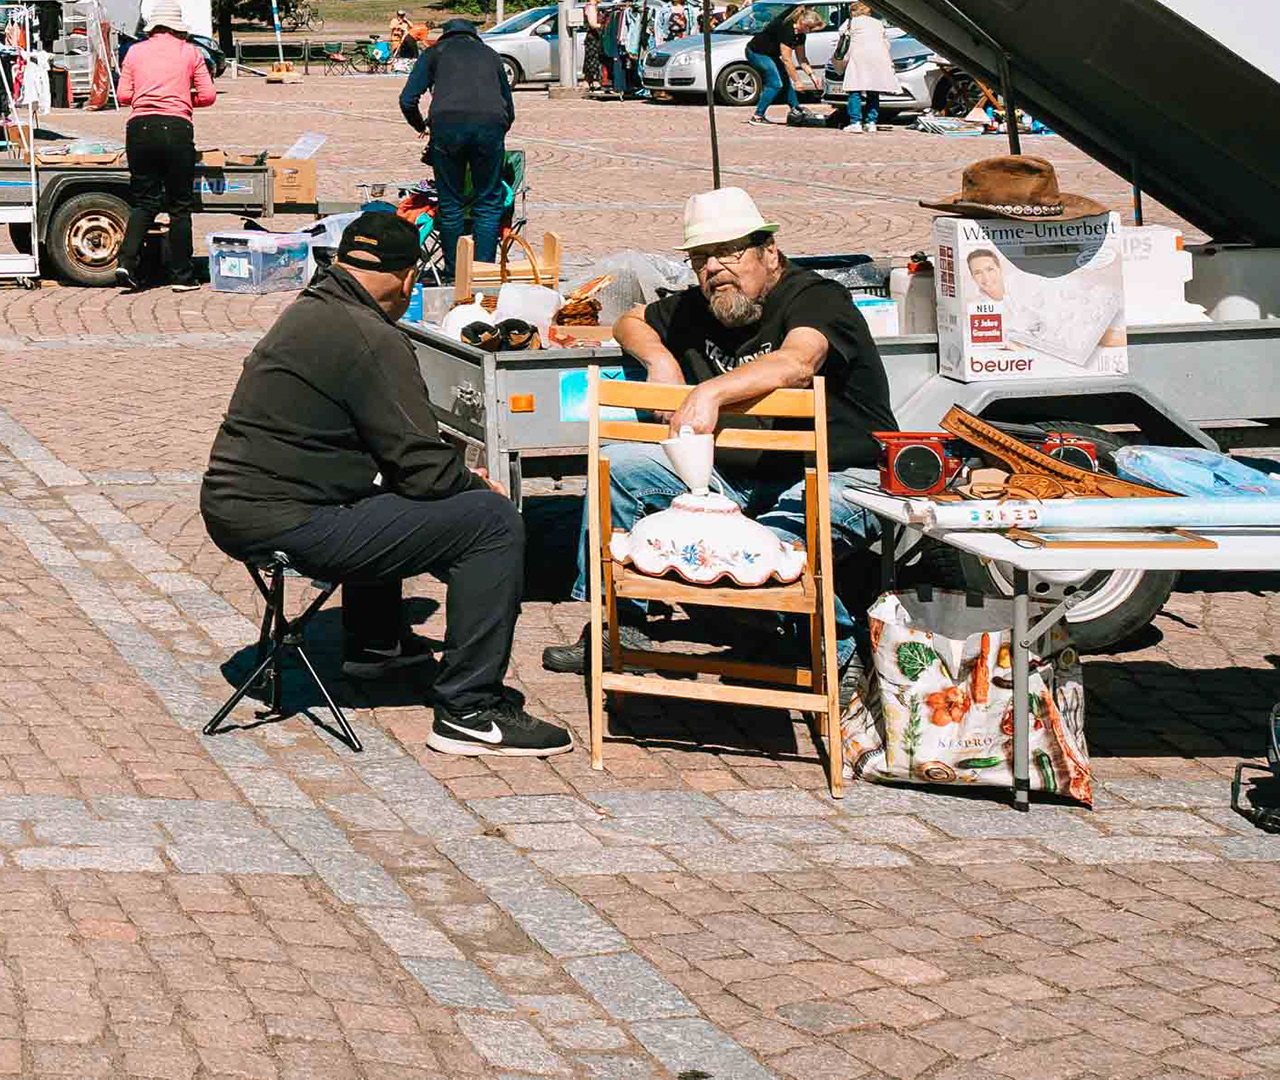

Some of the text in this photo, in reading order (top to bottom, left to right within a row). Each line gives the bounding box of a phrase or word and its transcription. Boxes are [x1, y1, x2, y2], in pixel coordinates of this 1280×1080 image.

[962, 221, 1116, 240] Wärme-Unterbett
[976, 304, 994, 313] NEU
[974, 319, 979, 327] 5
[970, 356, 1034, 372] beurer
